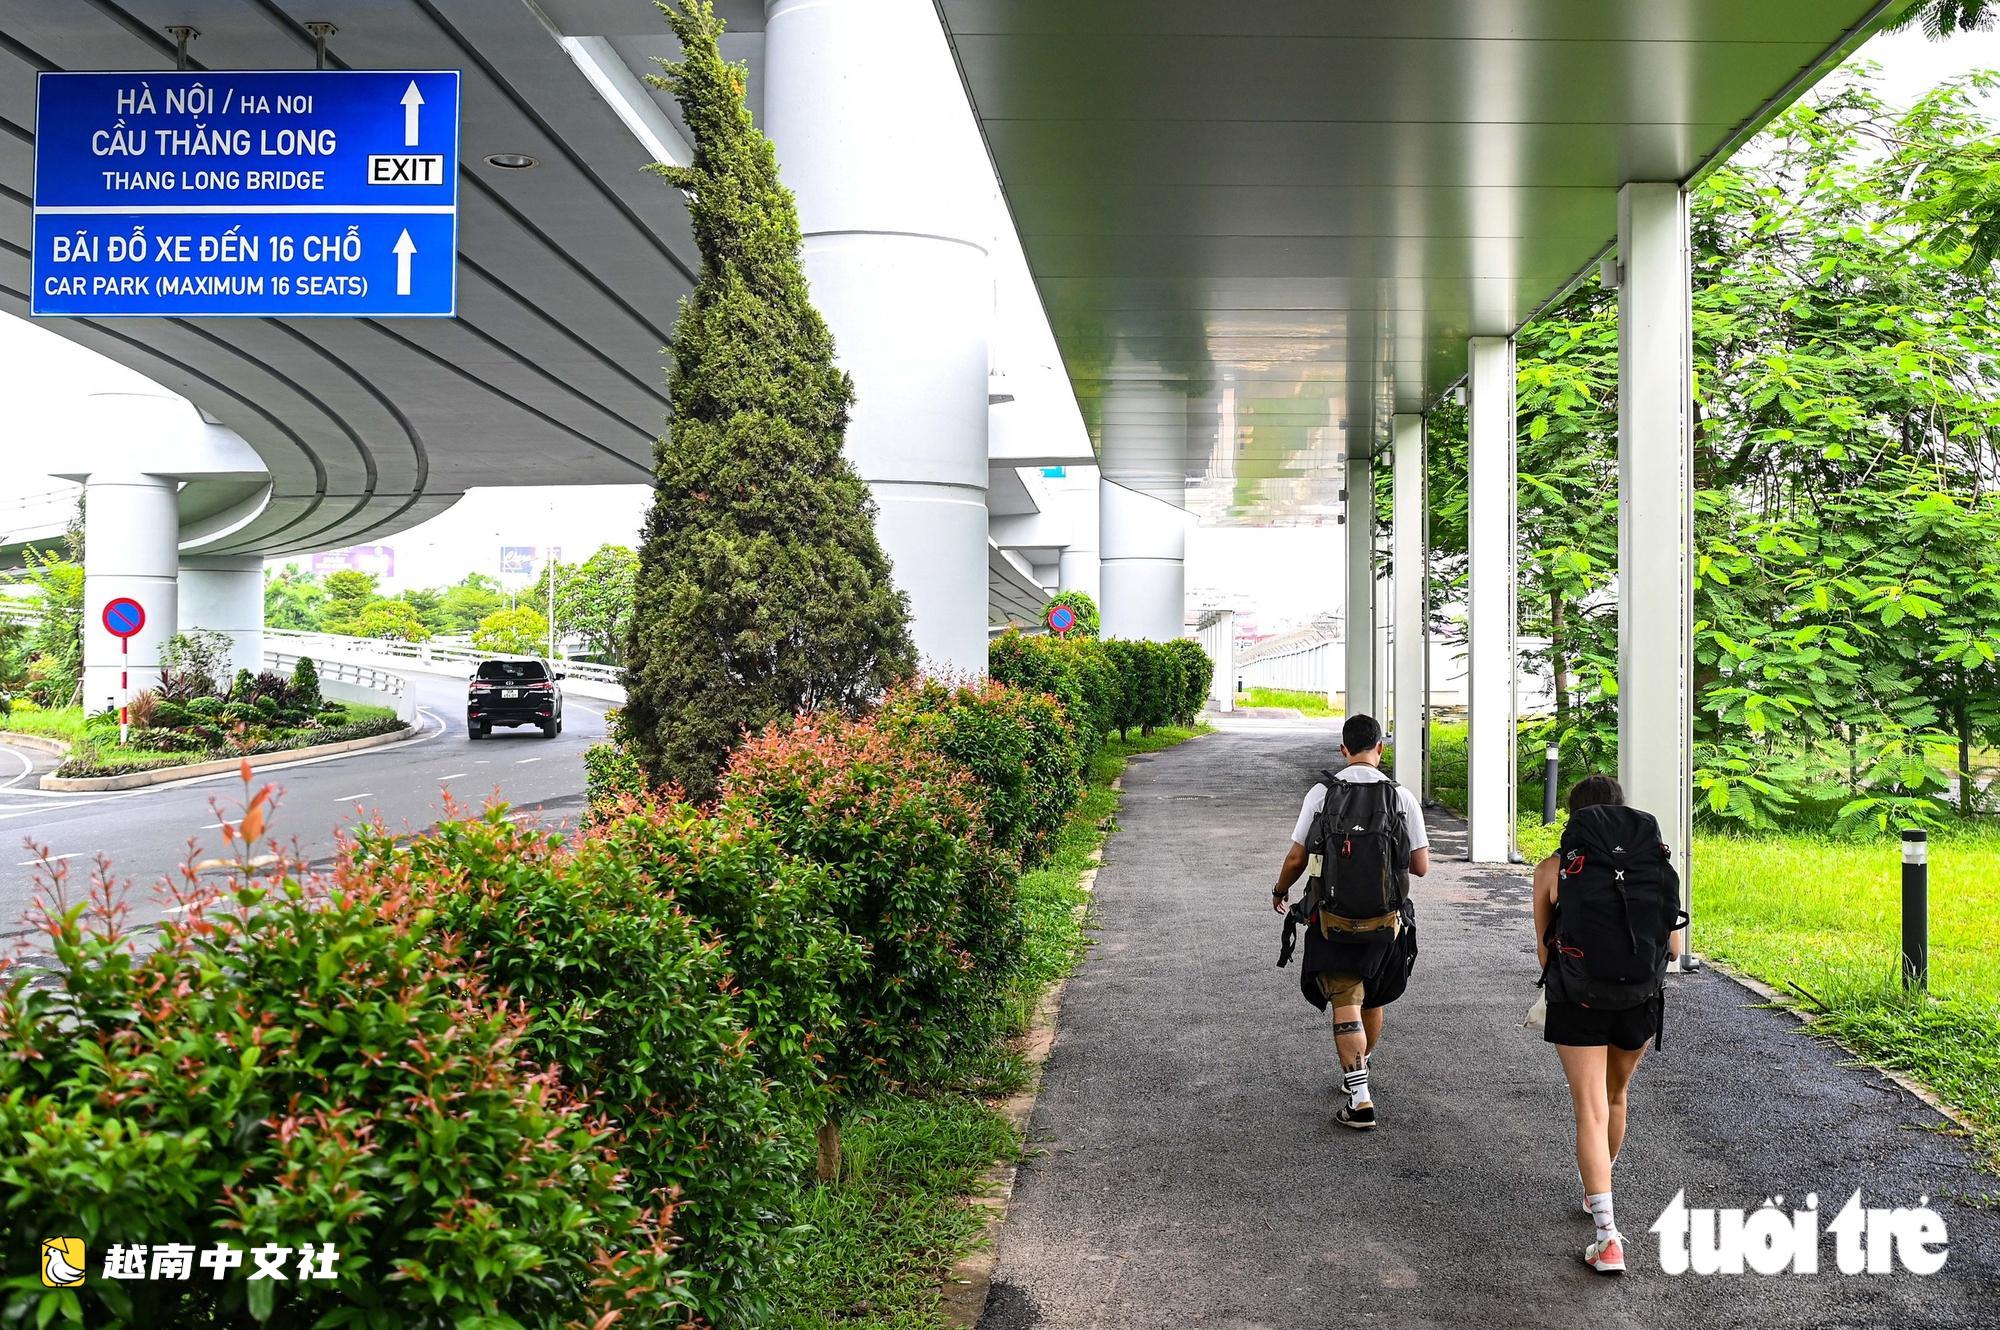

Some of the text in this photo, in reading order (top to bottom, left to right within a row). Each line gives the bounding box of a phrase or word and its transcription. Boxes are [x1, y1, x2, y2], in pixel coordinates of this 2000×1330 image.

[117, 82, 313, 120] HÀ NỘI / HA NOI
[92, 119, 336, 156] CẦU THĂNG LONG
[103, 171, 325, 190] THANG LONG BRIDGE
[374, 159, 436, 181] EXIT
[53, 225, 361, 262] BÃI ĐỖ XE ĐẾN 16 CHỖ
[45, 276, 368, 298] CAR PARK (MAXIMUM 16 SEATS)
